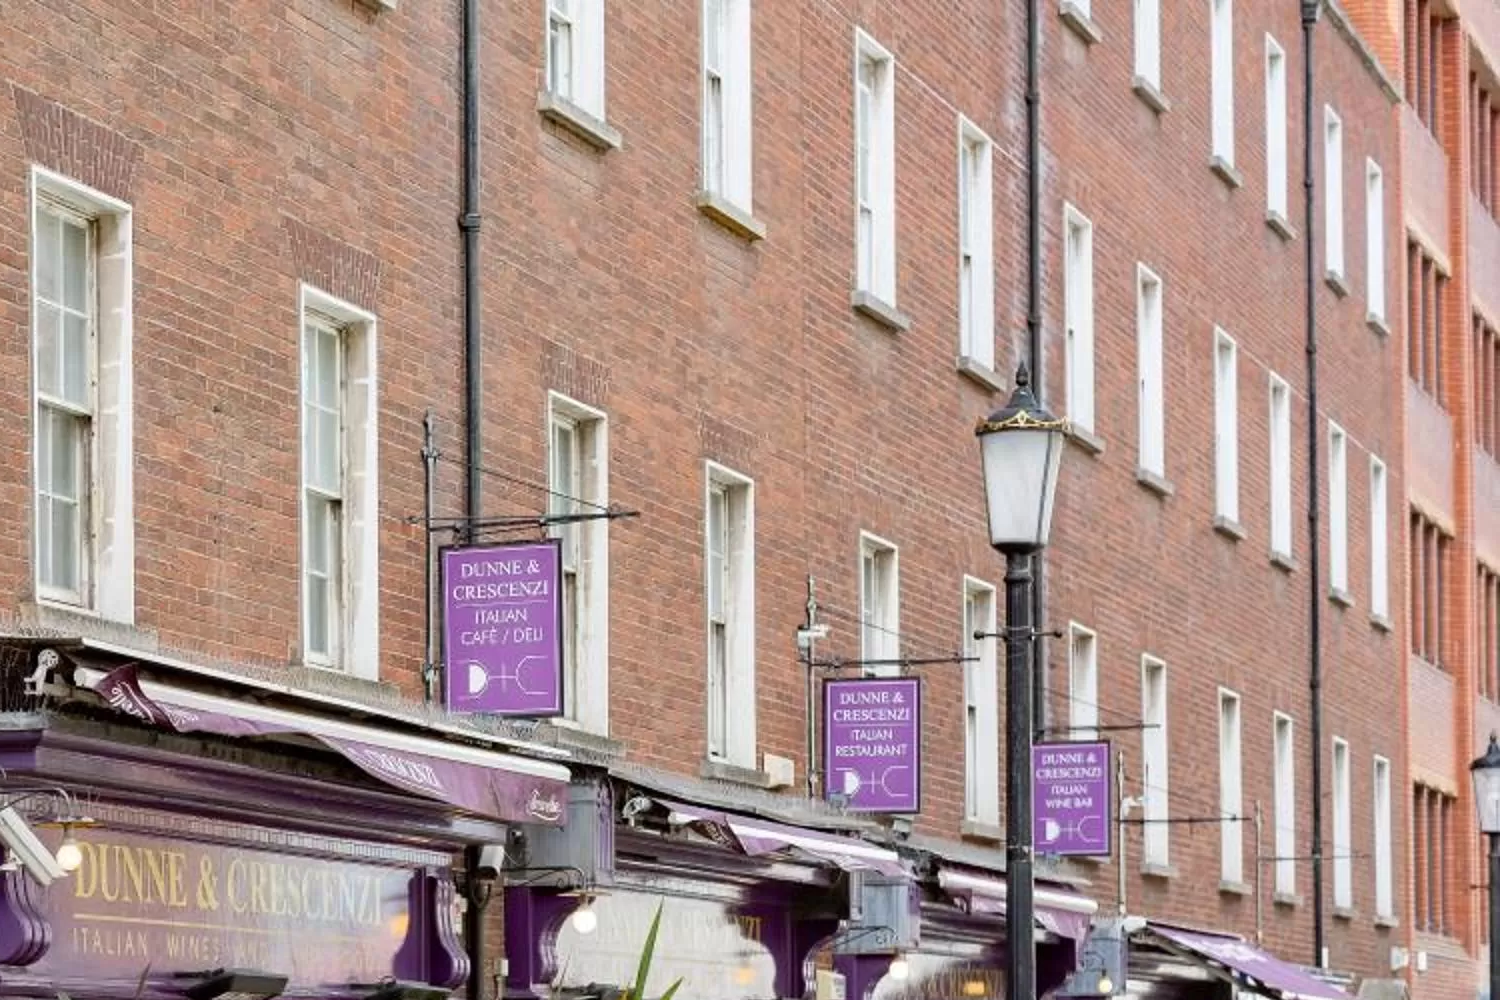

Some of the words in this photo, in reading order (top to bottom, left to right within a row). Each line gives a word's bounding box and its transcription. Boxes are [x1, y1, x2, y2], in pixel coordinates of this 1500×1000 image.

[461, 559, 523, 578] DUNNE
[527, 559, 541, 575] &
[453, 580, 549, 601] CRESCENZI
[475, 608, 528, 625] ITALIAN
[513, 627, 543, 643] DELI
[840, 691, 889, 705] DUNNE
[892, 692, 905, 703] &
[833, 707, 910, 721] CRESCENZI
[851, 728, 894, 741] ITALIAN
[835, 743, 908, 757] RESTAURANT
[1041, 752, 1085, 765] DUNNE
[1035, 767, 1102, 779] CRESCENZI
[75, 842, 188, 908] DUNNE
[196, 855, 220, 912] &
[227, 857, 384, 926] CRESCENZI
[72, 927, 149, 959] ITALIAN
